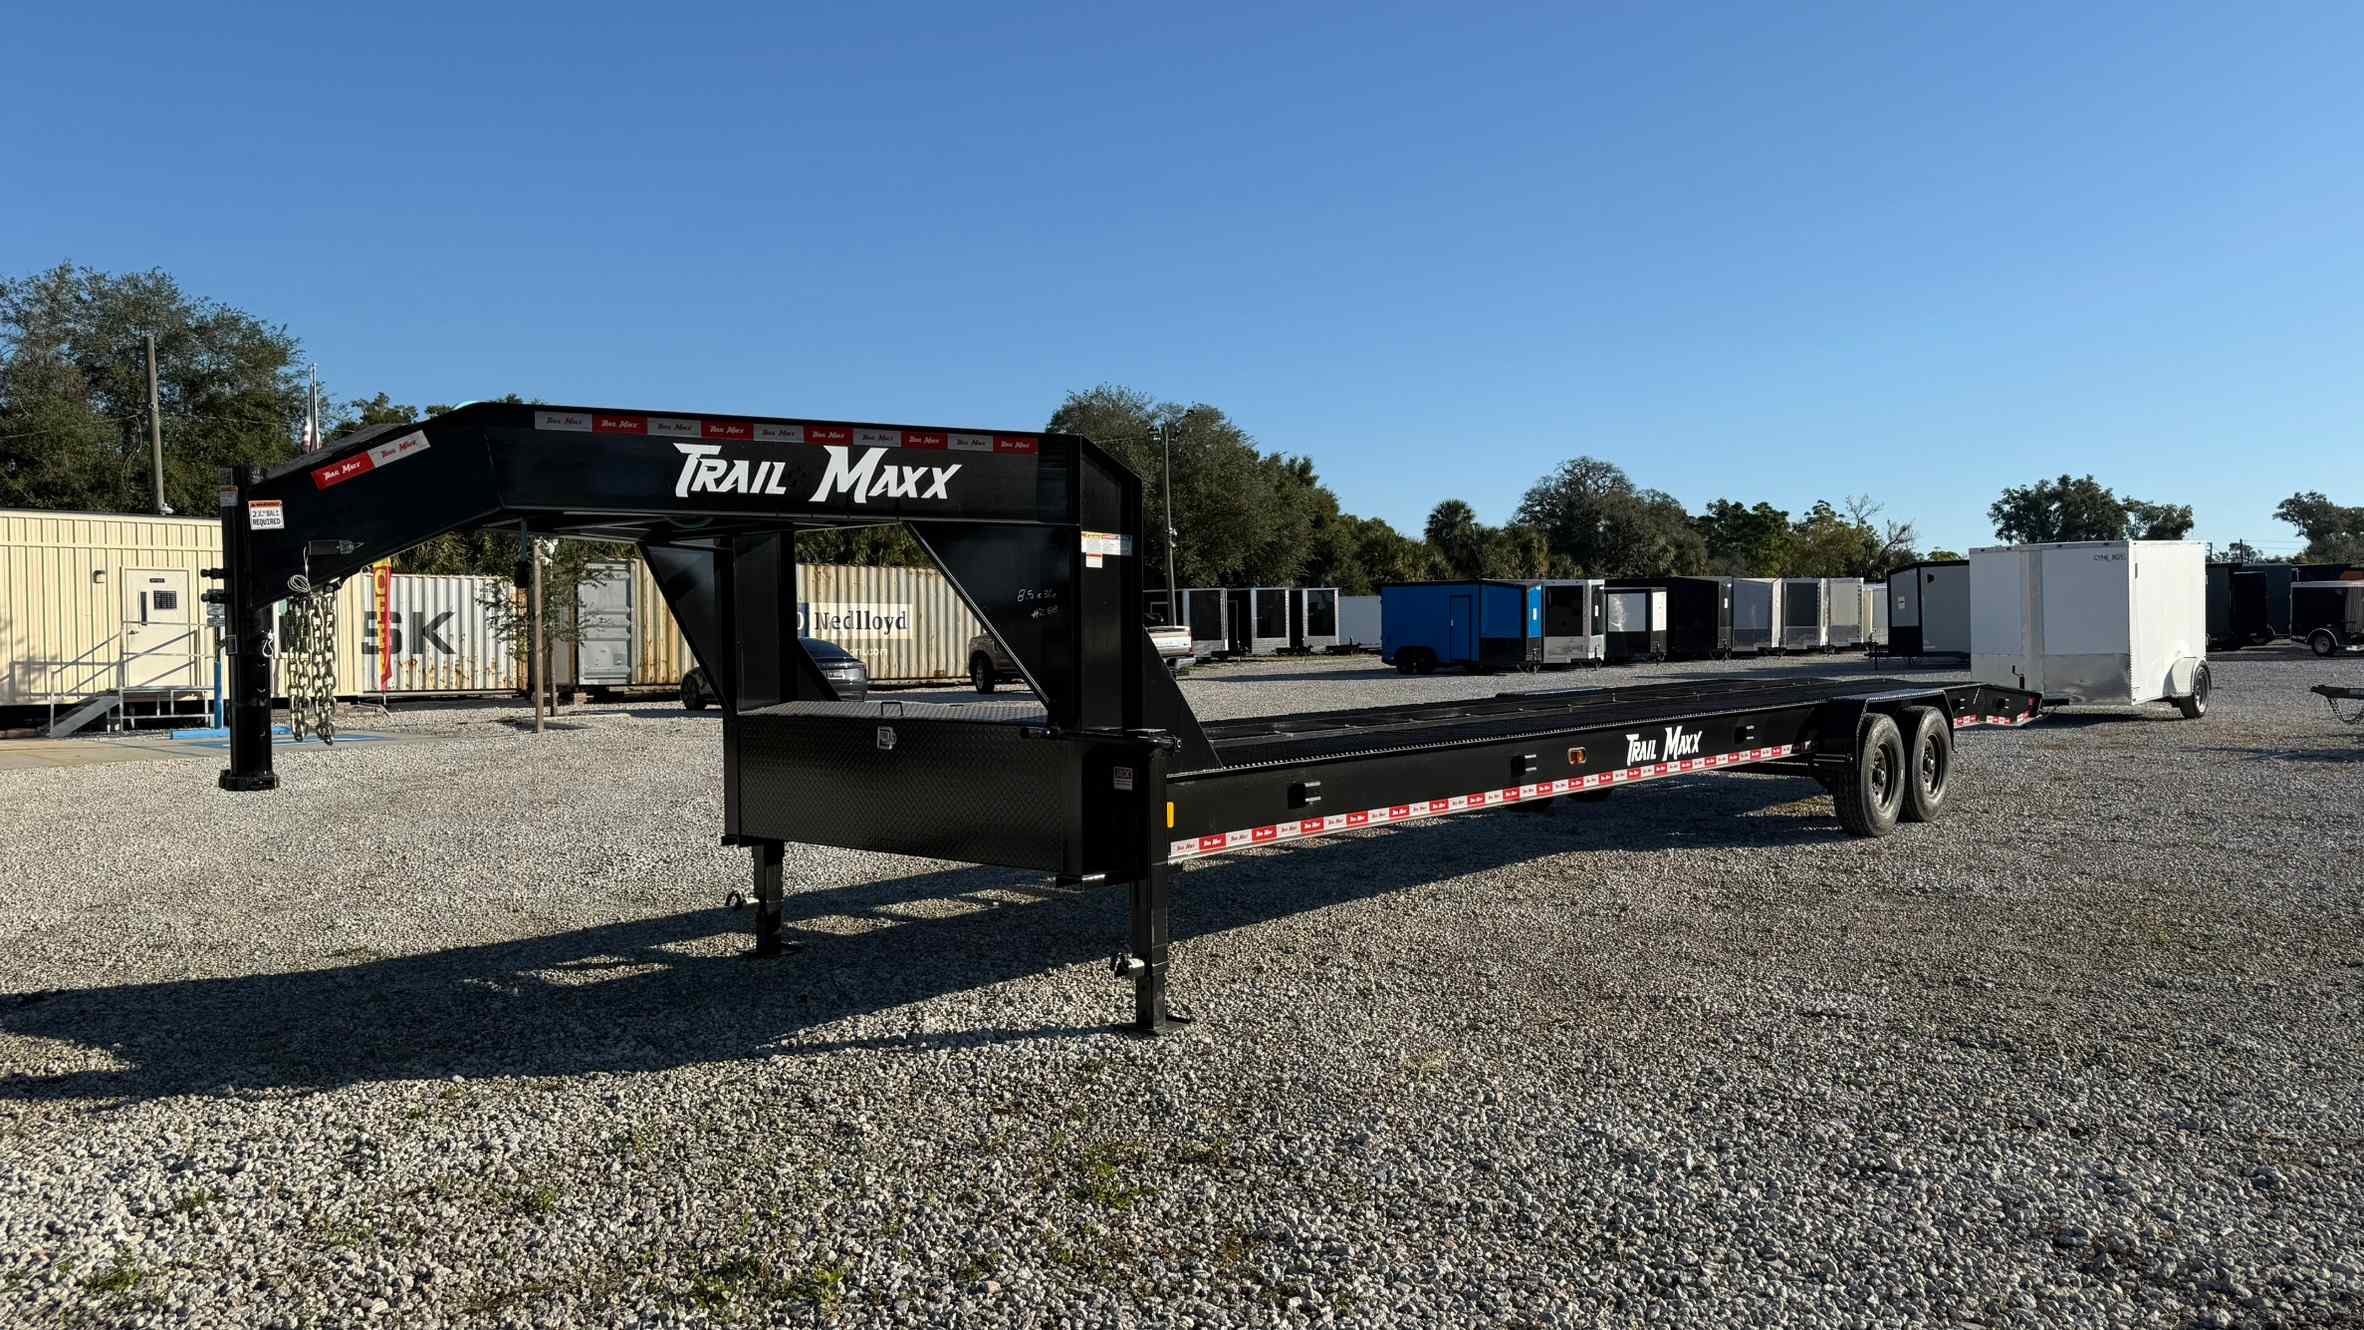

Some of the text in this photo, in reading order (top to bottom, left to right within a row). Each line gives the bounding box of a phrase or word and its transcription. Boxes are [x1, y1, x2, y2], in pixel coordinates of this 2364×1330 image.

[673, 443, 962, 503] TRAIL MAXX
[814, 609, 908, 635] Nedlloyd
[1625, 734, 1657, 767] TRAIL
[1662, 726, 1703, 761] MAXX
